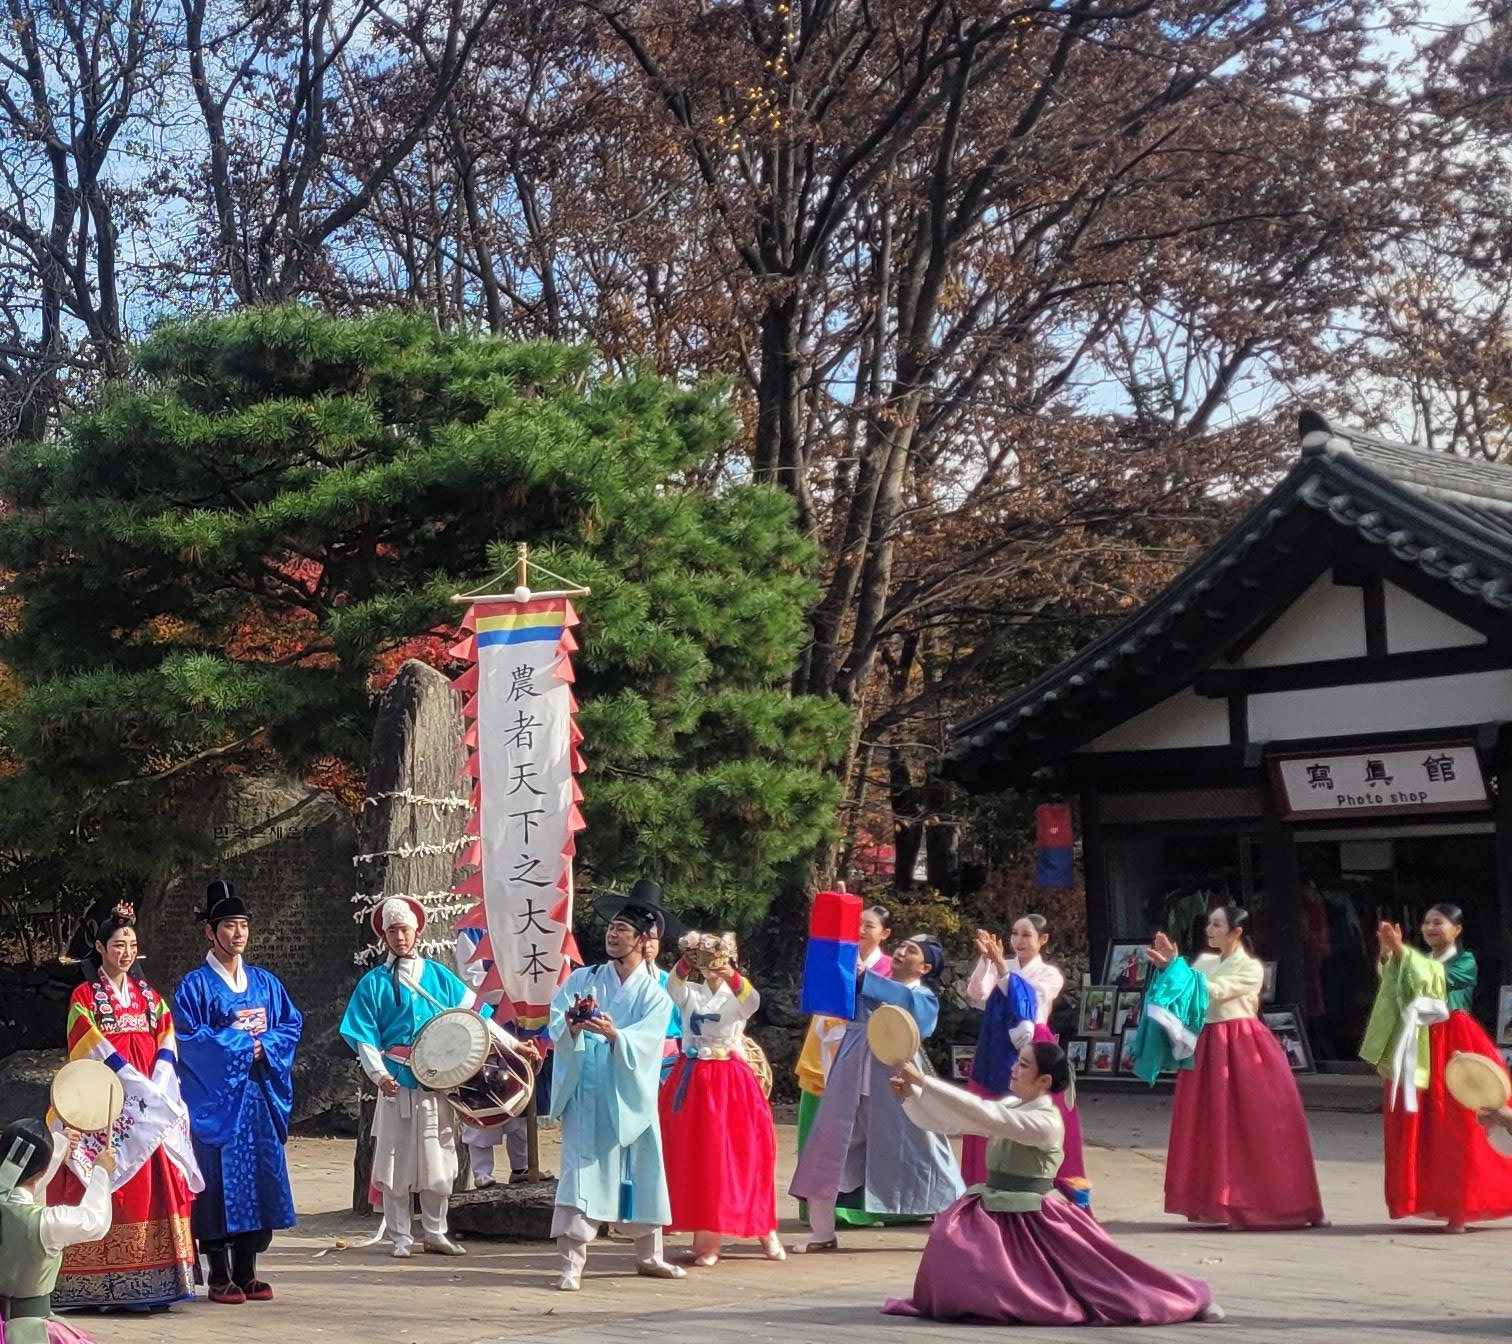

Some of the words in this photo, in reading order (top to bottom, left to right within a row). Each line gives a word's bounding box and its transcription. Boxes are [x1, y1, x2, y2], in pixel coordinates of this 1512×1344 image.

[503, 664, 557, 984] 農者天下之大本
[1337, 795, 1383, 806] Photo
[1391, 791, 1428, 803] shop
